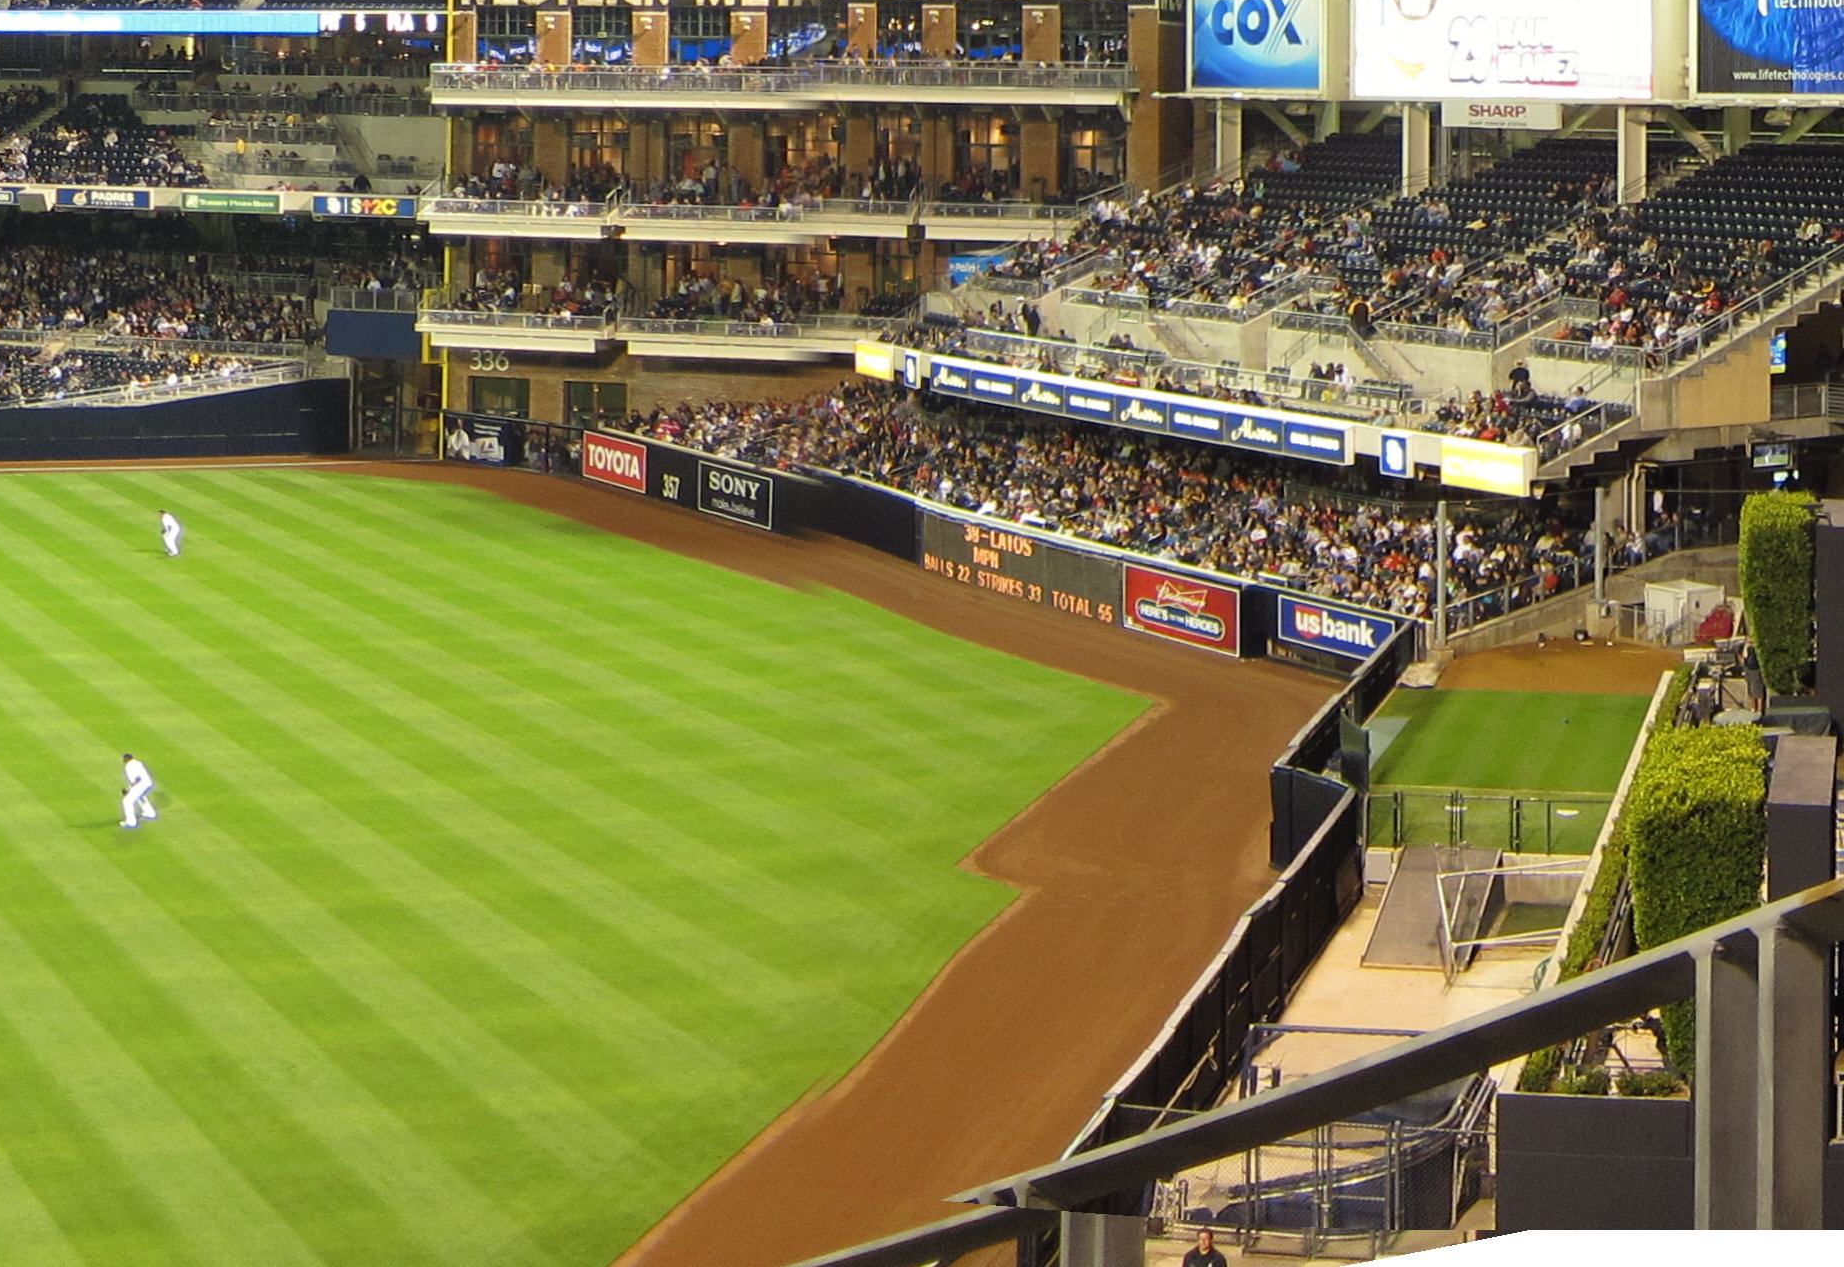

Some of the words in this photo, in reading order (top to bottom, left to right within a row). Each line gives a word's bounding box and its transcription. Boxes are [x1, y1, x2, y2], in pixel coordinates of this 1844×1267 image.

[1468, 104, 1526, 117] SHARP
[91, 191, 135, 202] PADRES
[469, 349, 510, 372] 336
[587, 443, 641, 480] TOYOTA
[662, 473, 680, 500] 357
[709, 470, 761, 501] SONY
[924, 553, 954, 578] BALLS
[957, 564, 971, 583] 22
[977, 570, 1023, 598] STRIKES
[1028, 584, 1043, 603] 33
[1052, 590, 1093, 618] TOTAL
[1185, 615, 1219, 635] HEROES
